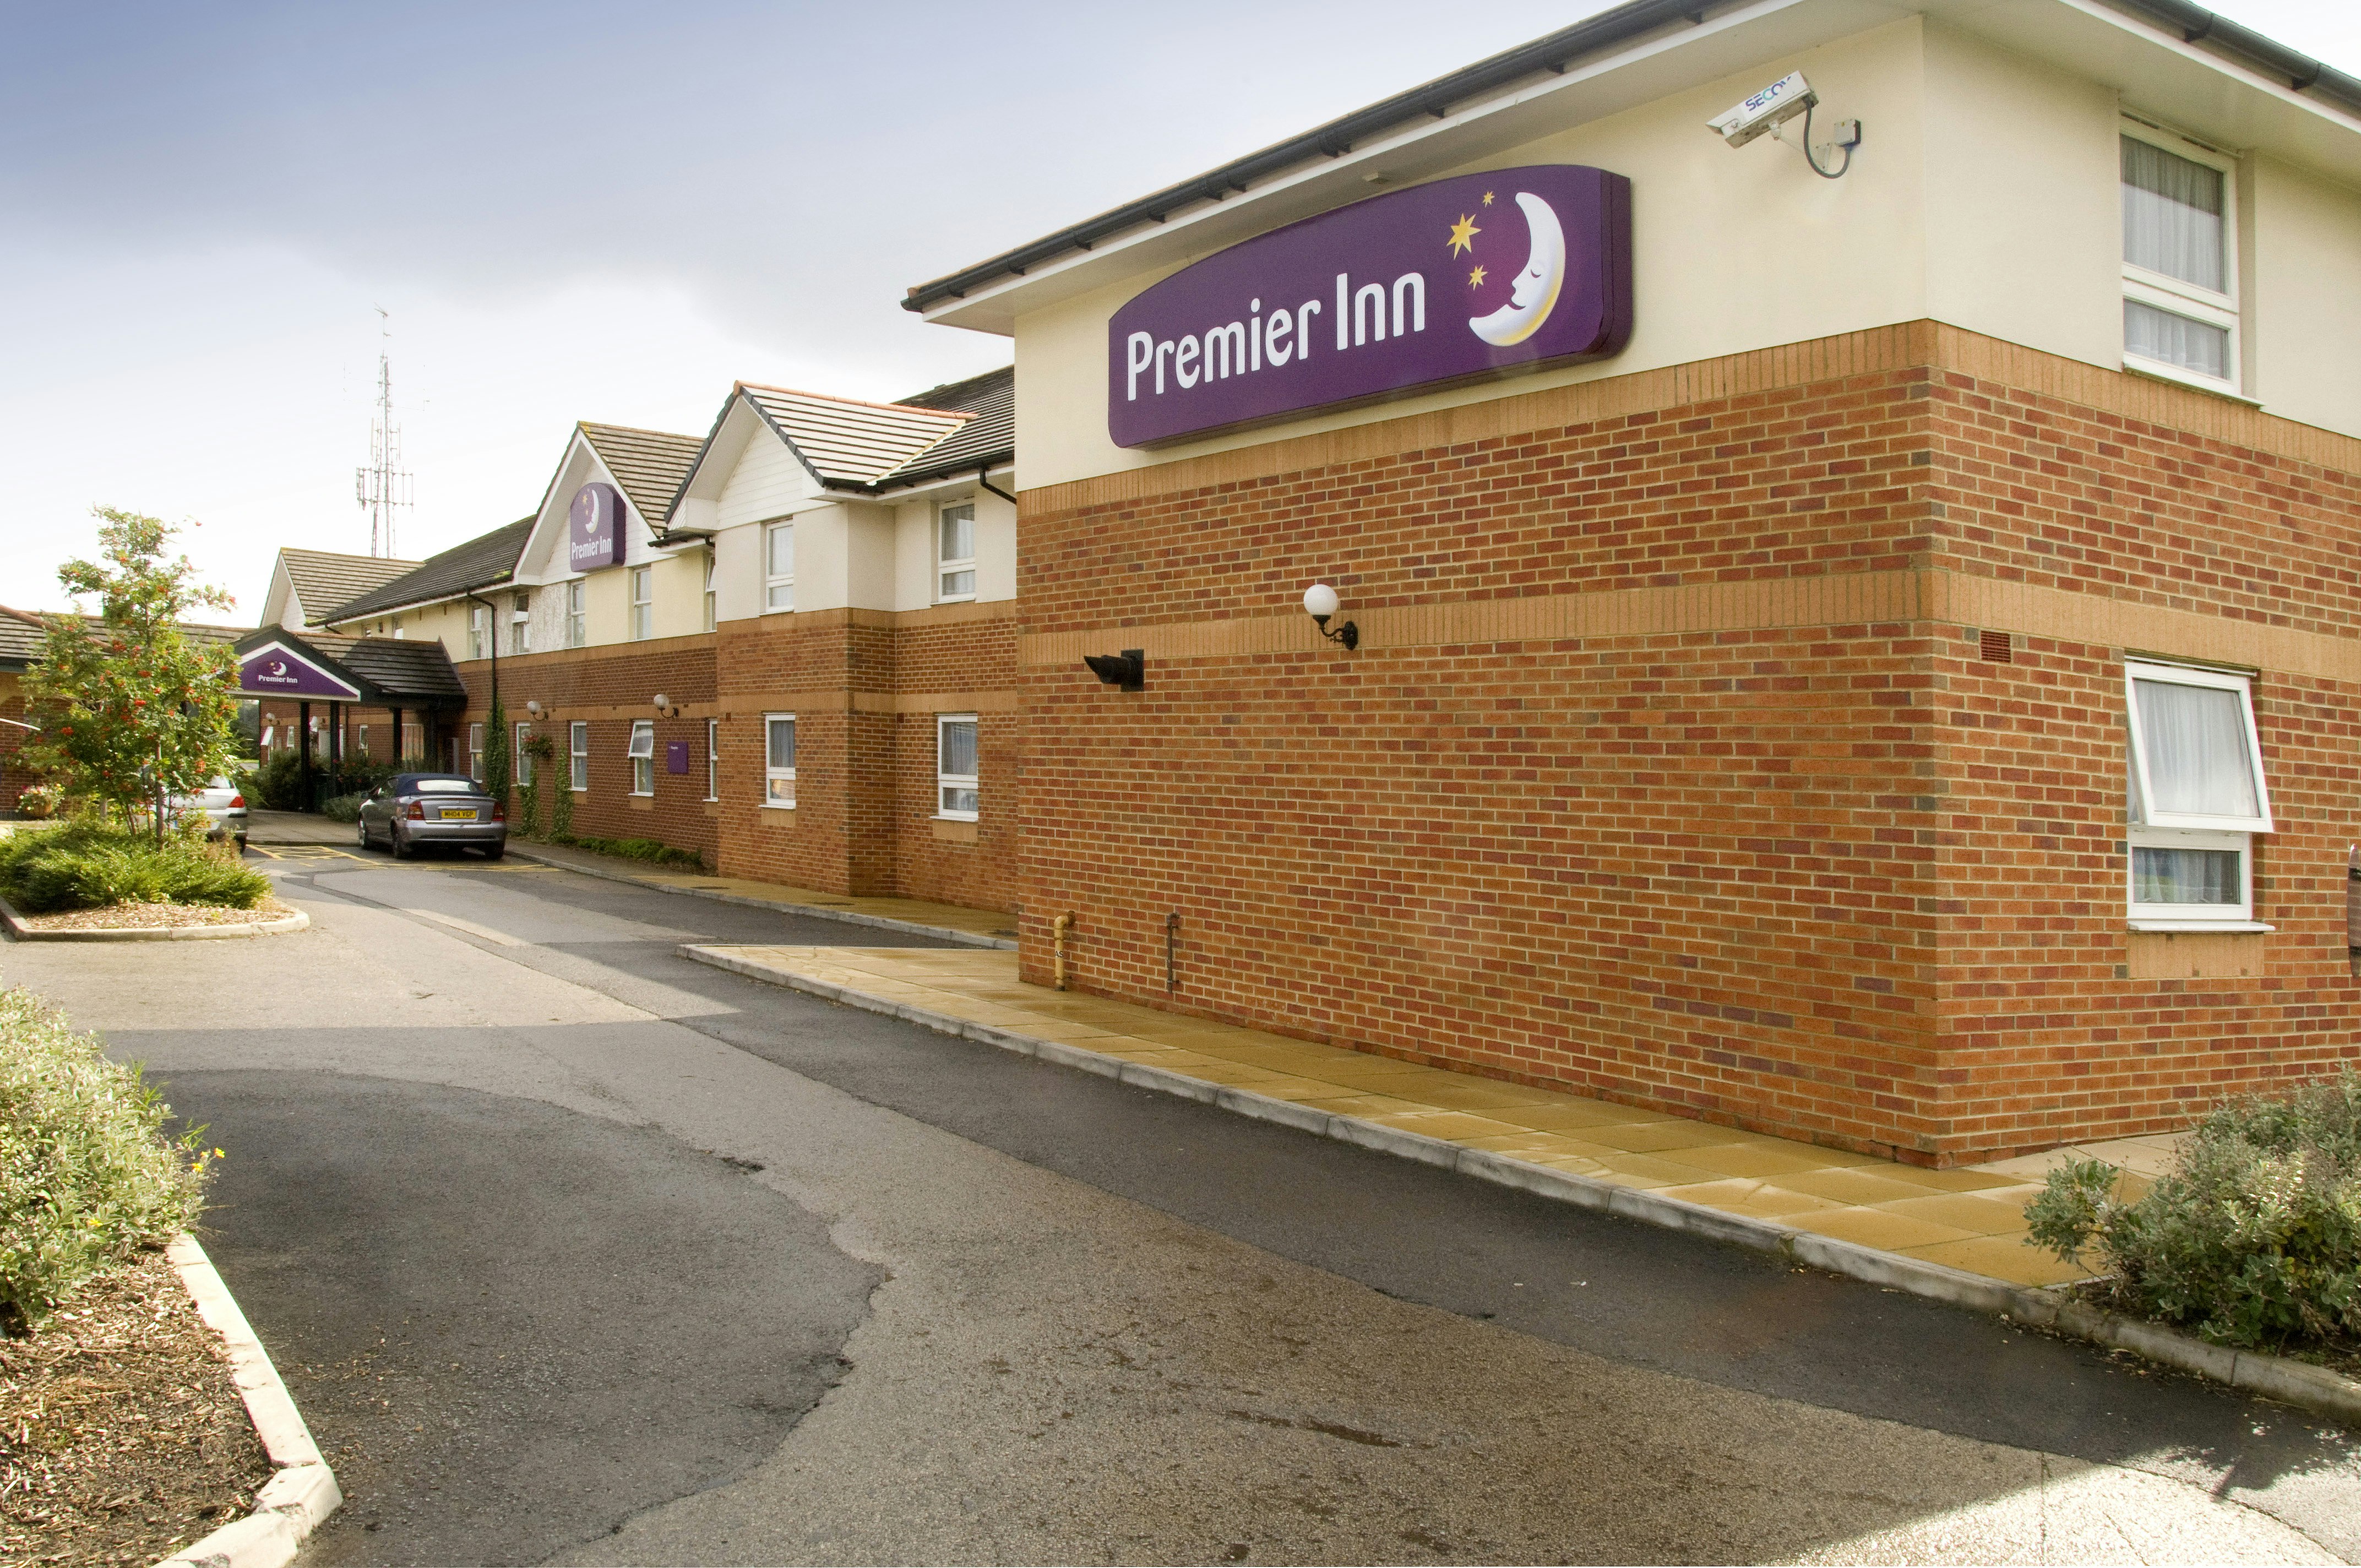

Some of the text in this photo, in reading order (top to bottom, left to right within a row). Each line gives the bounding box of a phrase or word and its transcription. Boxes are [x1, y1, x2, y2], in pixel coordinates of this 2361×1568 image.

[1745, 76, 1791, 111] SECO
[1128, 272, 1425, 401] Premier Inn
[572, 535, 612, 560] Premier Inn
[258, 674, 286, 683] Premier
